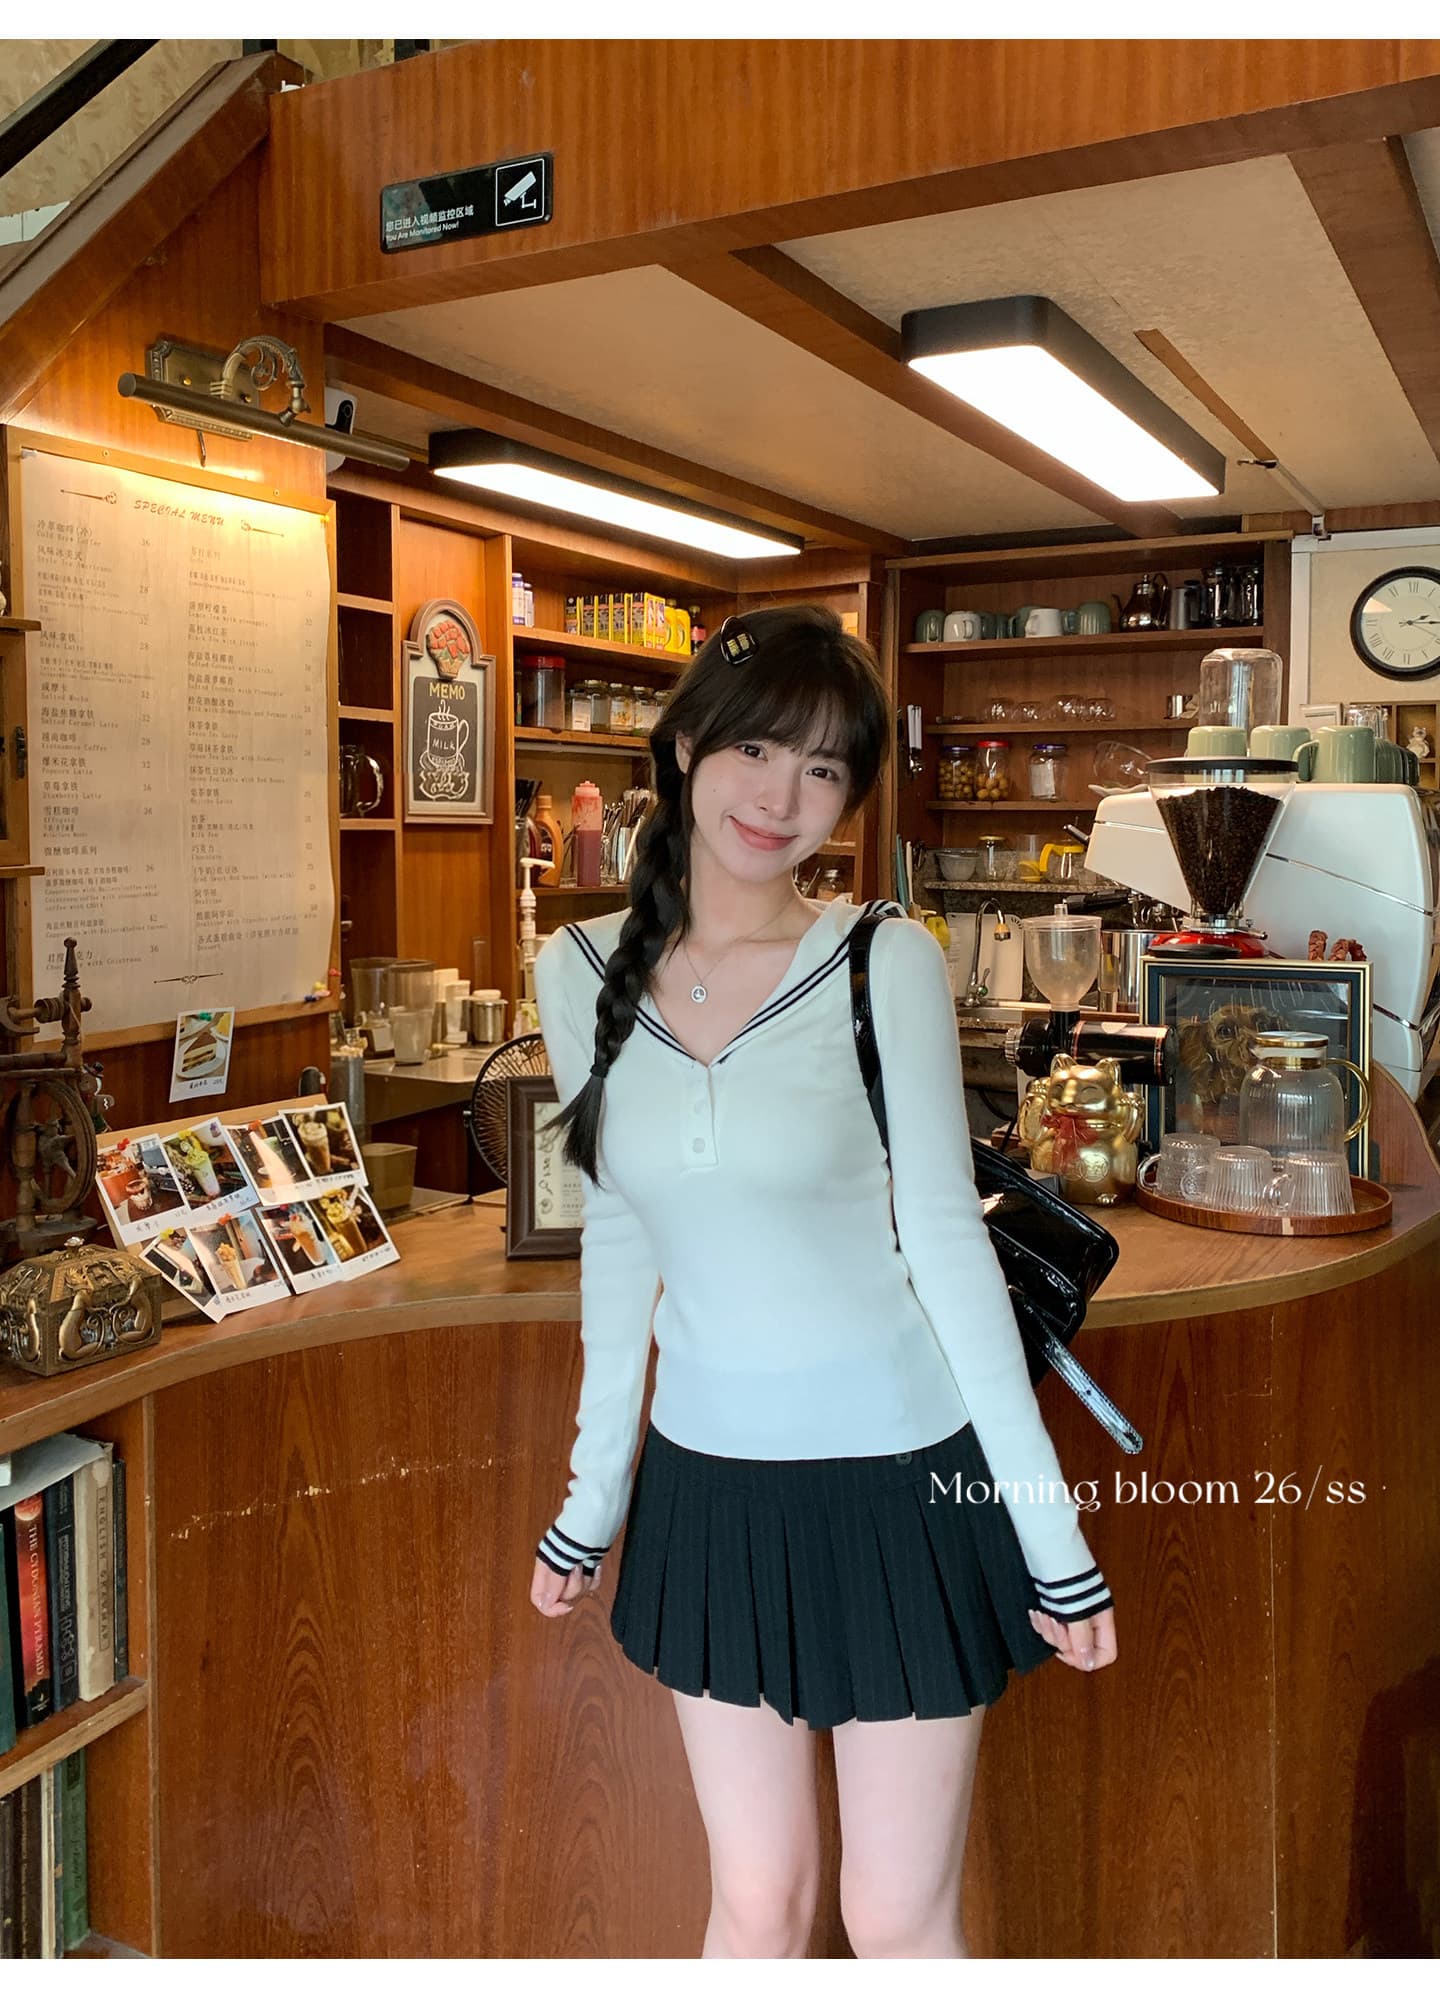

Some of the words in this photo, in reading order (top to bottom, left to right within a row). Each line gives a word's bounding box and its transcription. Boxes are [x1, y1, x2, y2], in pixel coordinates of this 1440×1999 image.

[385, 204, 474, 232] 您已进入视频监控区域
[385, 232, 397, 243] You
[397, 230, 408, 241] Are
[409, 223, 442, 239] Monitored
[442, 220, 460, 232] Now!
[134, 499, 186, 519] SPECIAL
[190, 510, 225, 527] MENU
[429, 682, 465, 701] MEMO
[432, 738, 456, 751] MILK
[28, 1524, 39, 1553] THE
[98, 1496, 108, 1561] ENGLISH
[99, 1571, 110, 1641] GRAMMAR
[33, 1619, 46, 1677] PYRAMID
